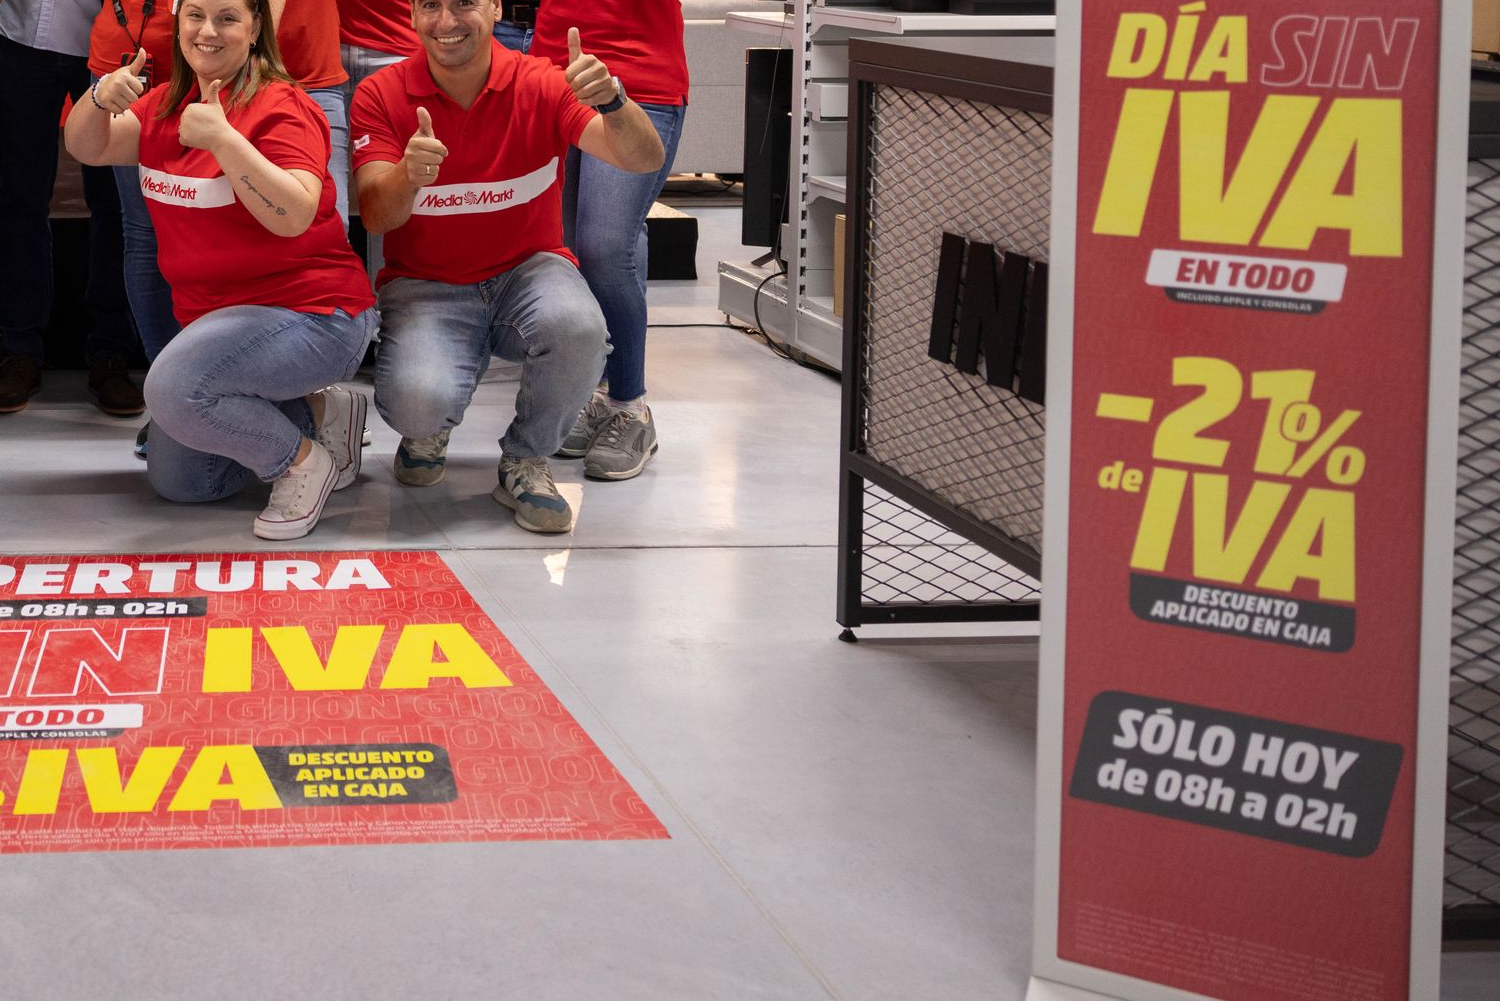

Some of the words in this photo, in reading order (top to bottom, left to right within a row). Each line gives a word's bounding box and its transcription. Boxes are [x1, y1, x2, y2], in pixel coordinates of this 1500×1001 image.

[1106, 1, 1248, 83] DÍA
[1260, 14, 1419, 90] SIN
[142, 176, 167, 197] Media
[170, 184, 198, 200] Markt
[1092, 88, 1403, 258] IVA
[419, 194, 463, 208] Media
[476, 188, 514, 204] Markt
[1176, 258, 1216, 287] EN
[1227, 261, 1315, 293] TODO
[1096, 356, 1365, 485] -21%
[1098, 461, 1143, 493] de
[1130, 466, 1356, 602] IVA
[19, 602, 91, 618] 08h
[94, 605, 118, 617] a
[122, 600, 189, 616] 02h
[1183, 585, 1299, 619] DESCUENTO
[1150, 600, 1249, 634] APLICADO
[1251, 615, 1280, 637] EN
[1283, 620, 1331, 647] CAJA
[202, 622, 514, 694] IVA
[41, 730, 108, 738] CONSOLAS
[1113, 707, 1235, 767] SÓLO
[1242, 731, 1359, 791] HOY
[288, 750, 434, 767] DESCUENTO
[295, 765, 426, 781] APLICADO
[12, 745, 284, 815] IVA
[303, 782, 339, 798] EN
[343, 780, 408, 799] CAJA
[1097, 758, 1146, 797] de
[1154, 768, 1234, 815] 08h
[1241, 788, 1264, 820] a
[1274, 793, 1357, 841] 02h
